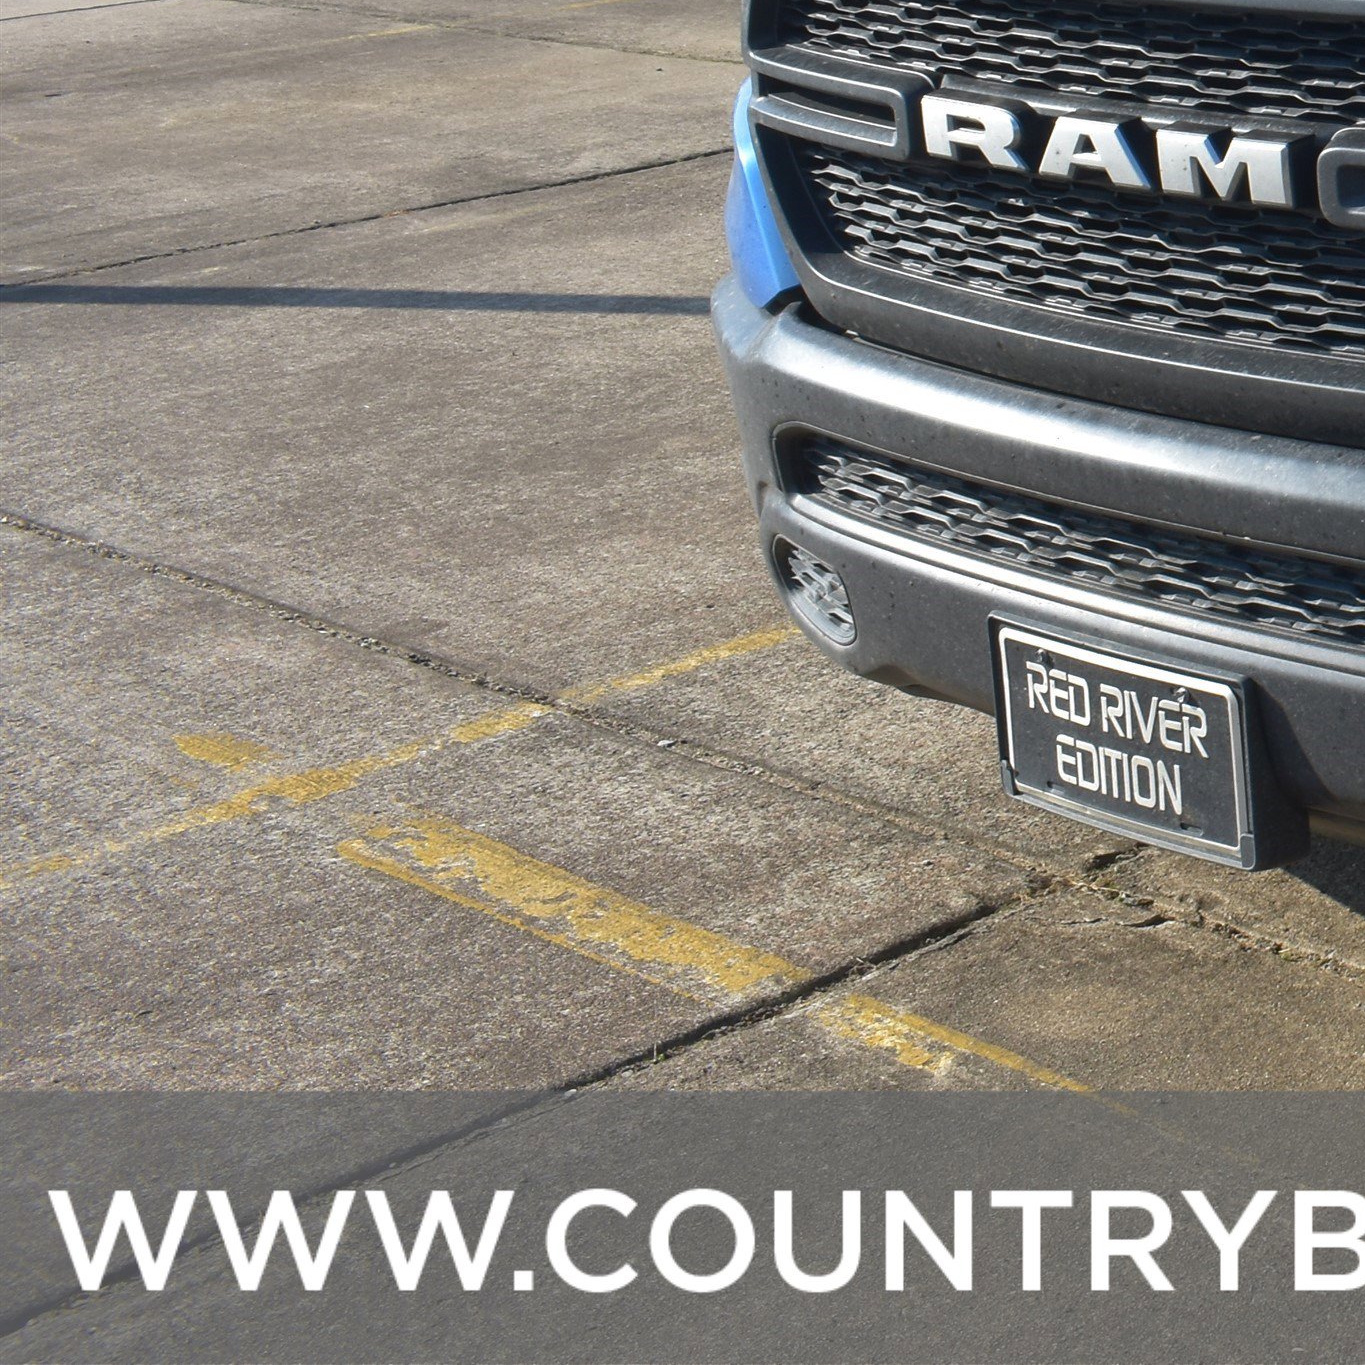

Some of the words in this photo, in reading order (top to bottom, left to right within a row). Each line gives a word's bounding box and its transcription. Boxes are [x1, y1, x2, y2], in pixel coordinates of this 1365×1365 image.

[921, 92, 1294, 207] RAM
[1025, 661, 1091, 727] RED
[1099, 683, 1210, 759] RIVER
[1056, 733, 1183, 816] EDITION
